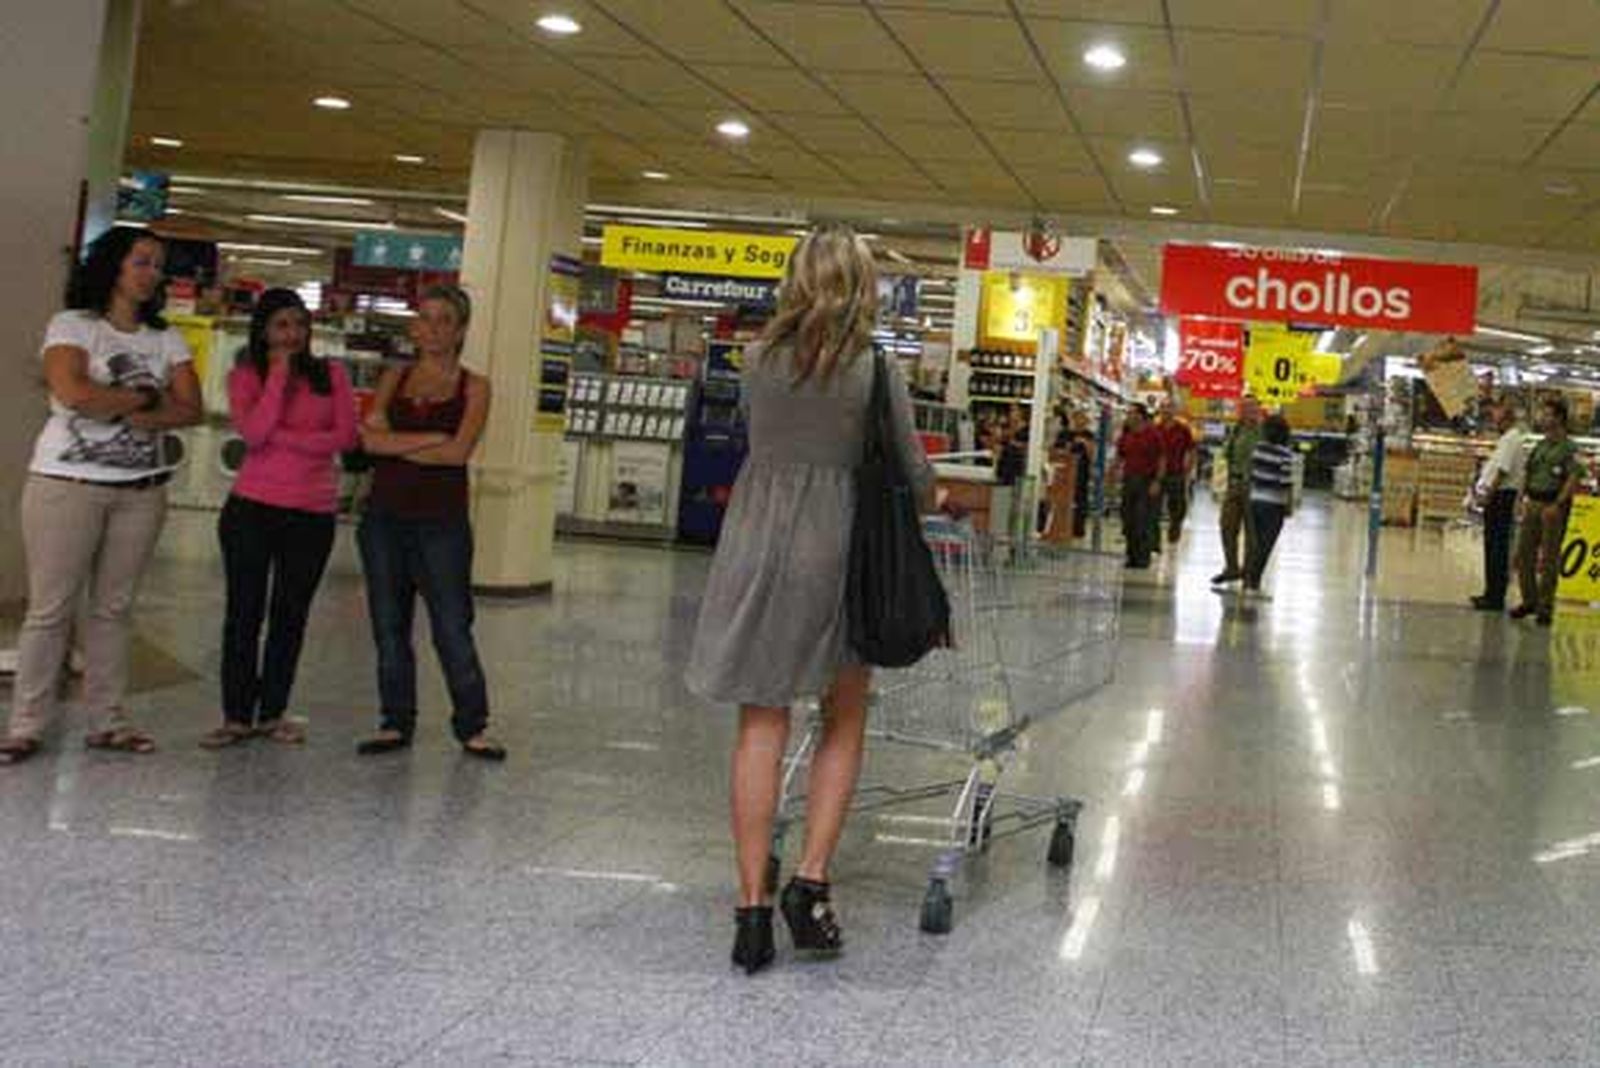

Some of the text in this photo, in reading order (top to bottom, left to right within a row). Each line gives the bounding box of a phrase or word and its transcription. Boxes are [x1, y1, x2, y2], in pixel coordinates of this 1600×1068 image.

[622, 236, 717, 260] Finanzas
[724, 246, 736, 263] y
[666, 276, 767, 299] Carrefour
[1225, 267, 1411, 319] chollos
